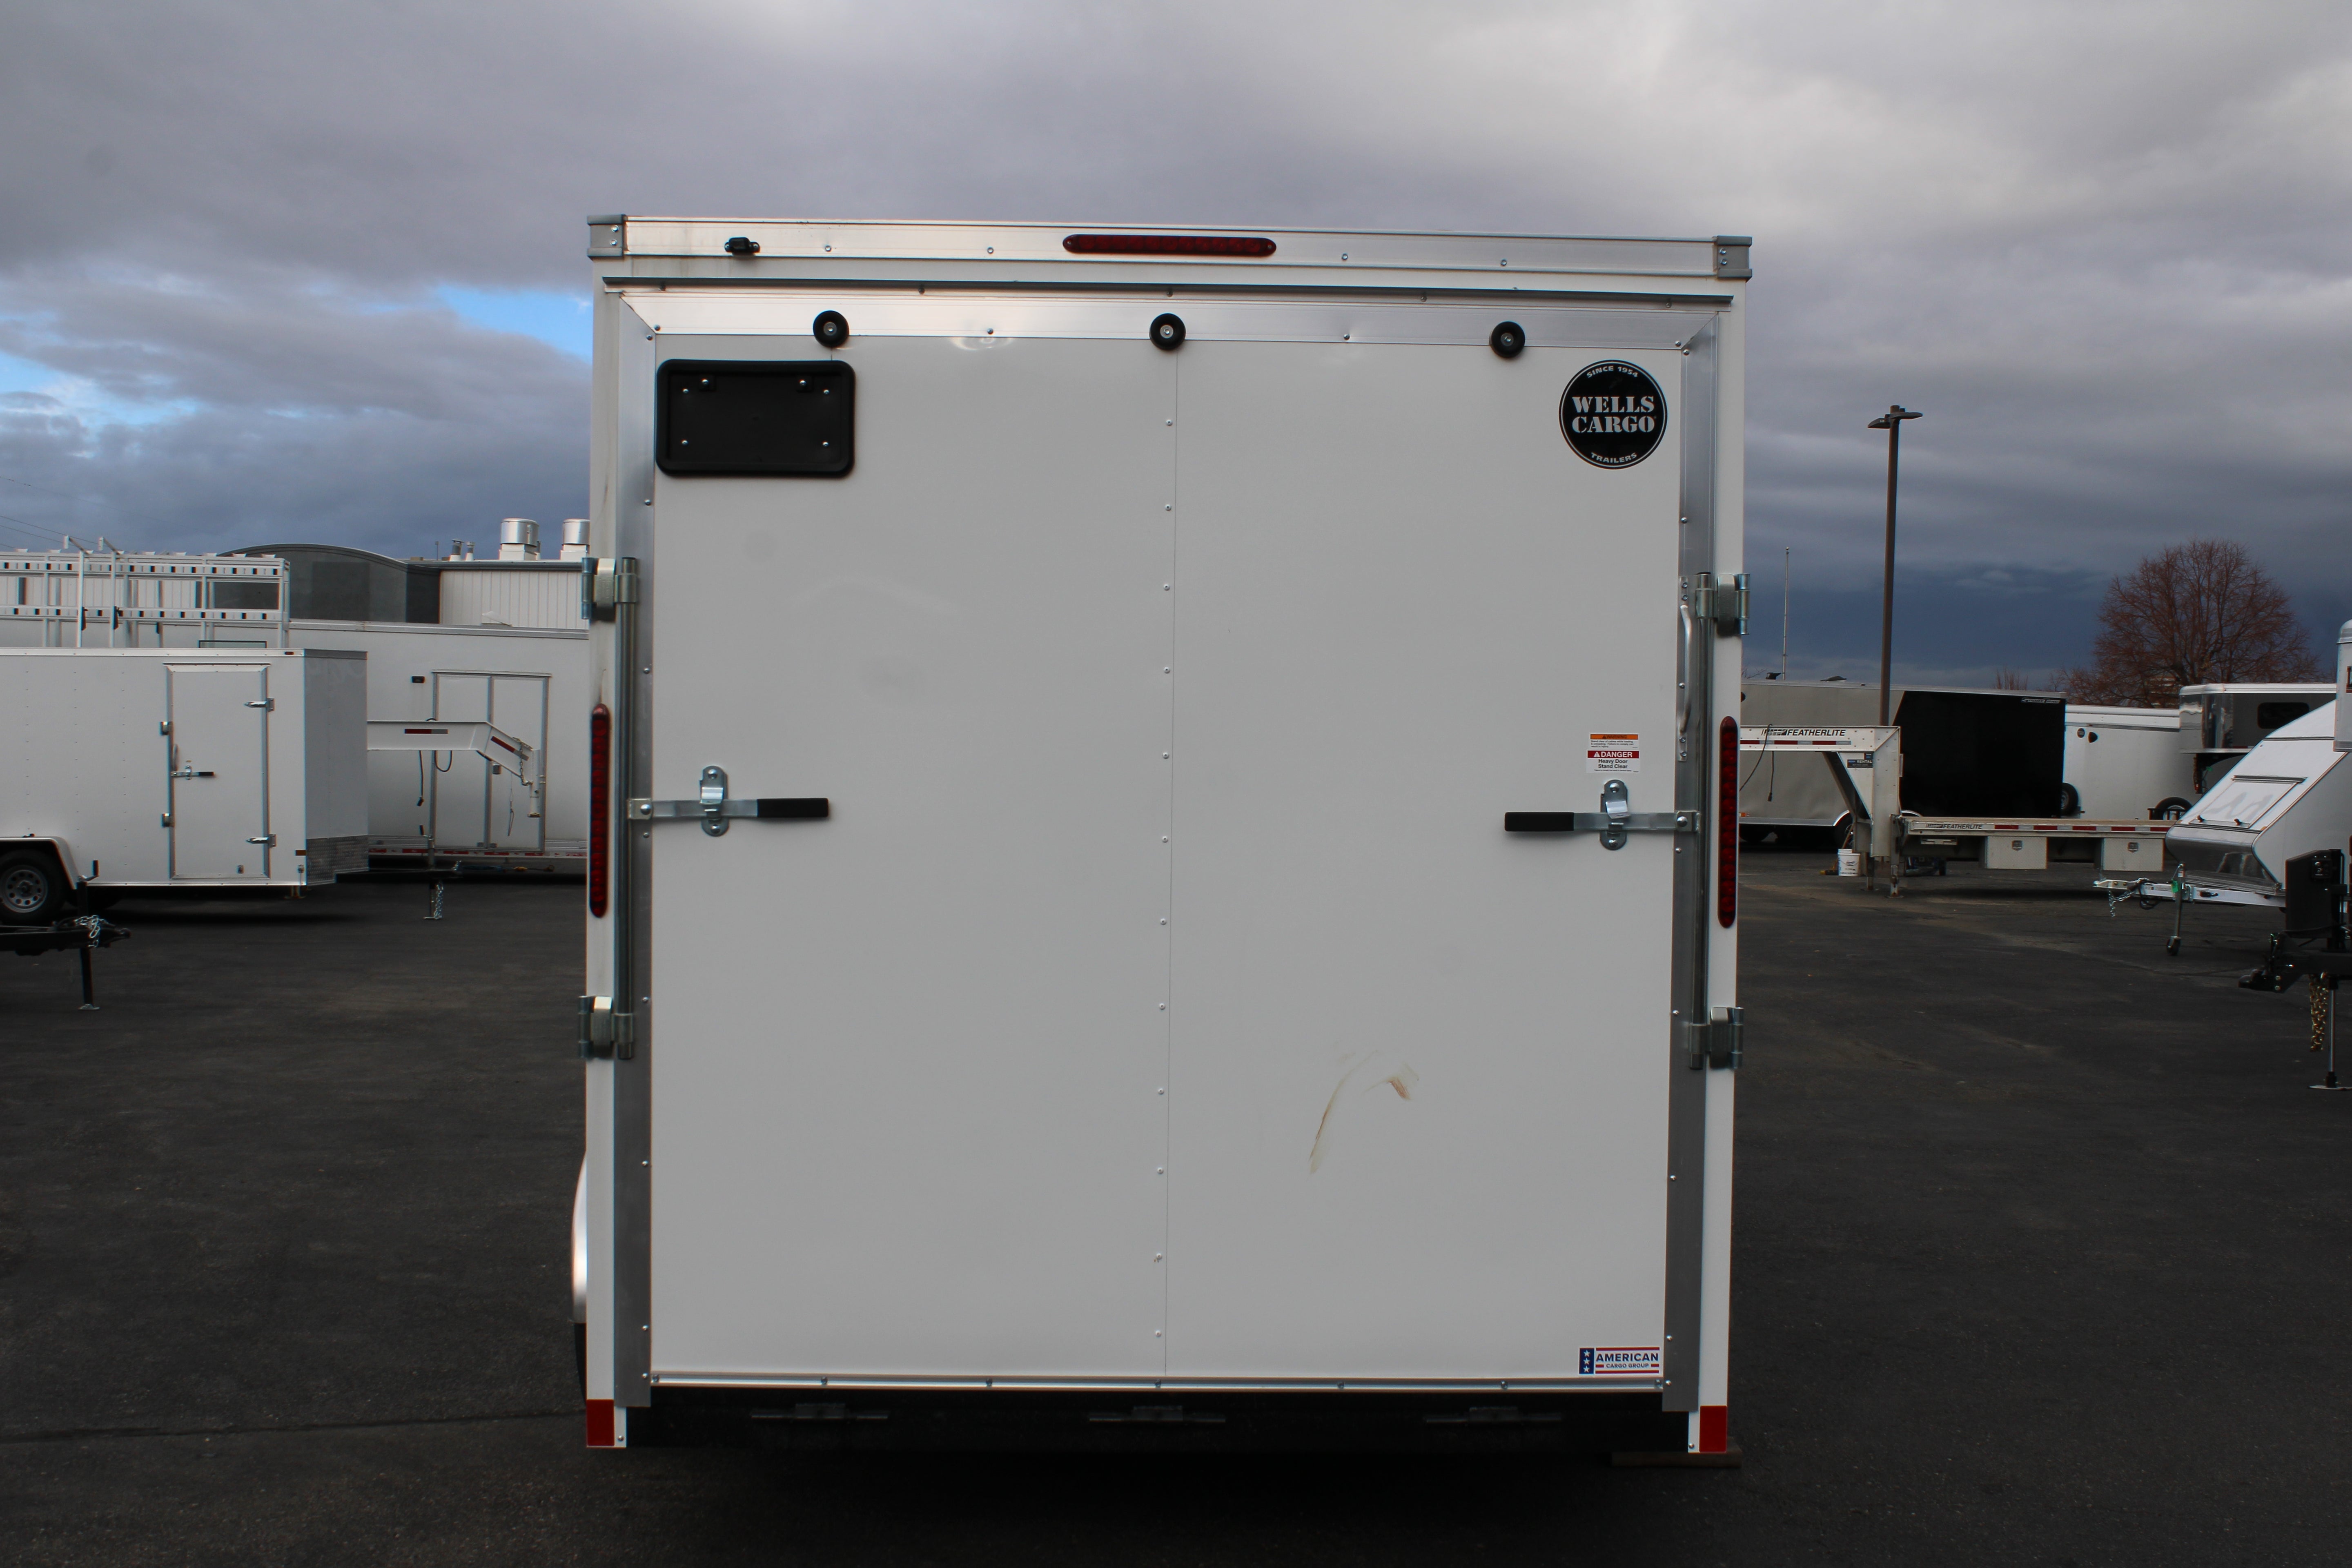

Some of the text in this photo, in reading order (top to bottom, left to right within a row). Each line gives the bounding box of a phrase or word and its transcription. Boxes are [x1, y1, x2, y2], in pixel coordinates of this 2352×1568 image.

[1586, 366, 1638, 378] SINCE 1954
[1572, 396, 1655, 413] WELLS
[1572, 416, 1655, 433] CARGO
[1591, 452, 1637, 463] TRAILERS
[1596, 1353, 1659, 1362] AMERICAN
